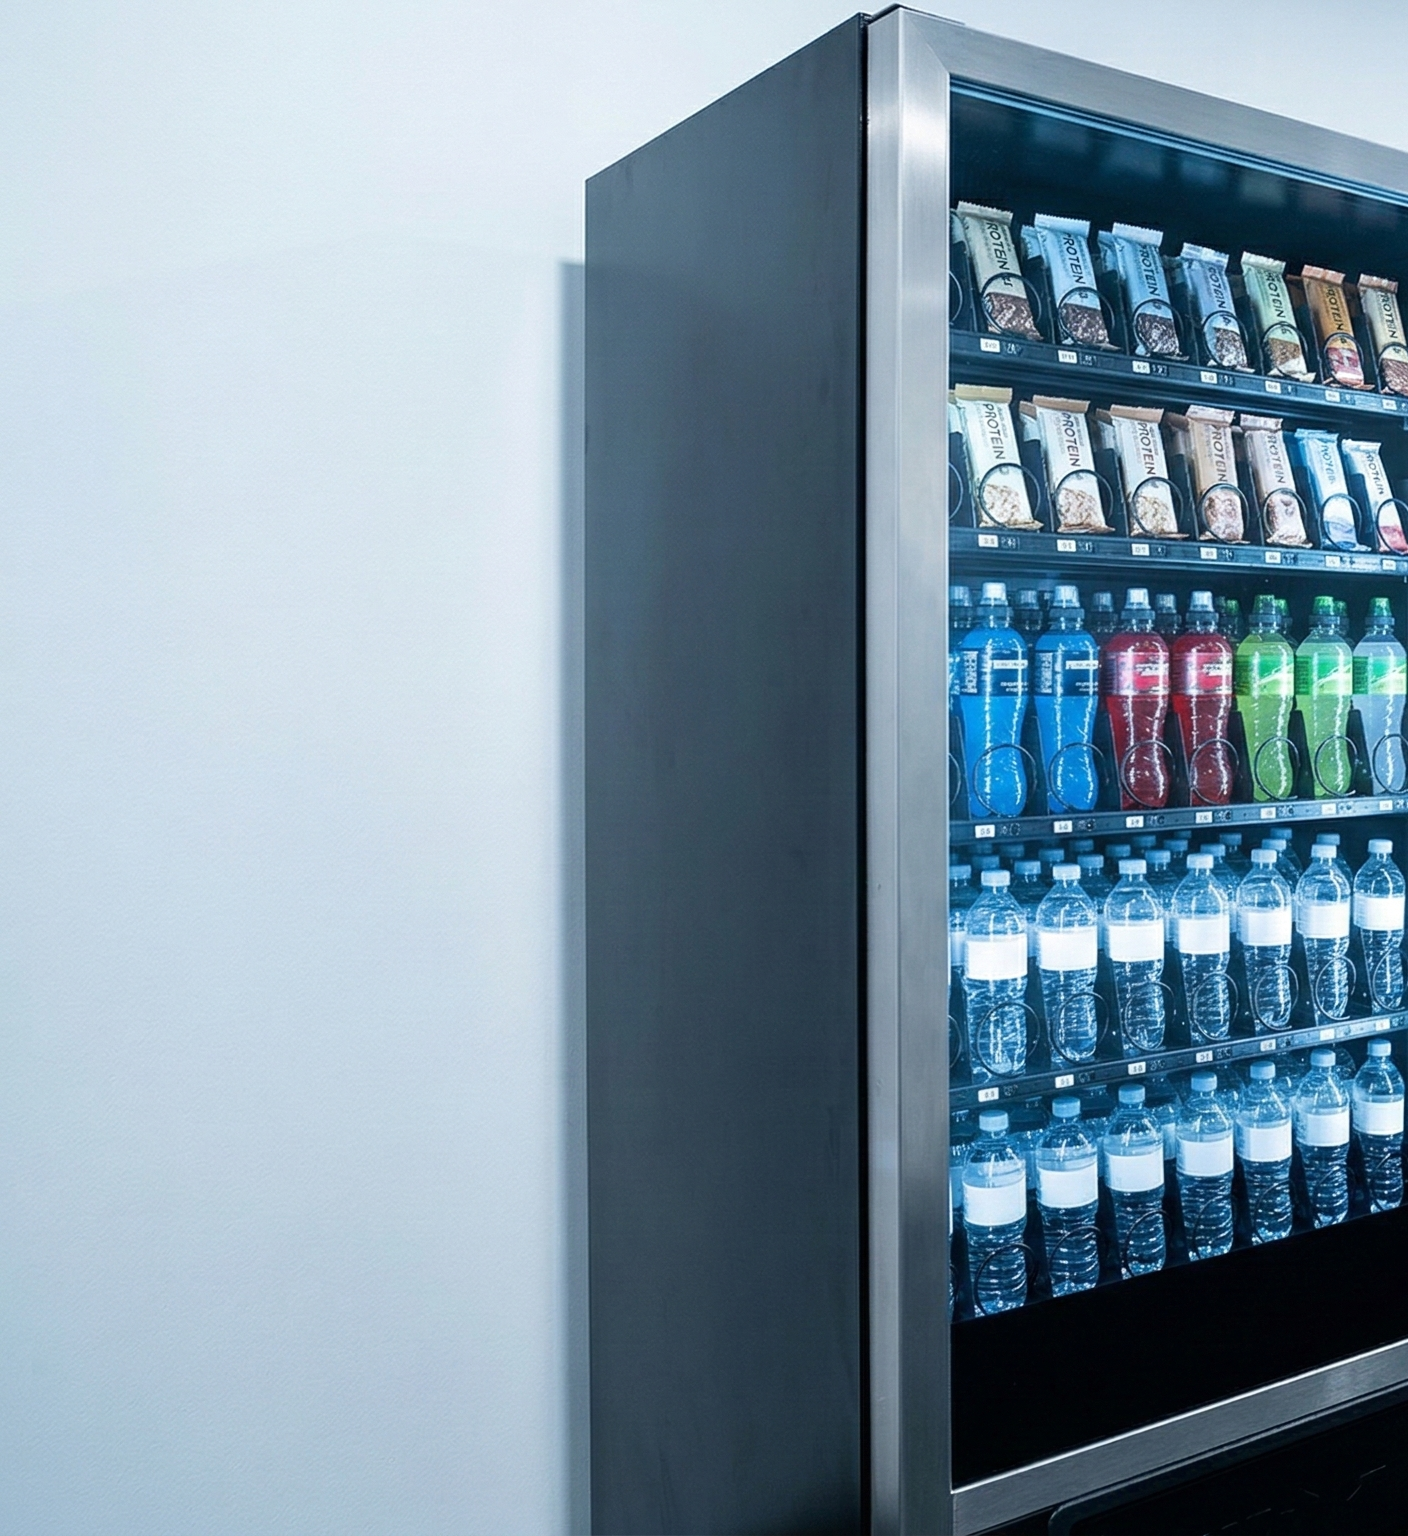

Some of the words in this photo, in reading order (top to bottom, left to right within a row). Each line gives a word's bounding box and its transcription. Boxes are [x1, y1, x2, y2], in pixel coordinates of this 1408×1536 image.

[985, 221, 1011, 271] ROTEIN
[982, 403, 1006, 460] PROTEIN
[1061, 412, 1081, 467] PROTEIN
[1137, 421, 1157, 475] PROTEIN
